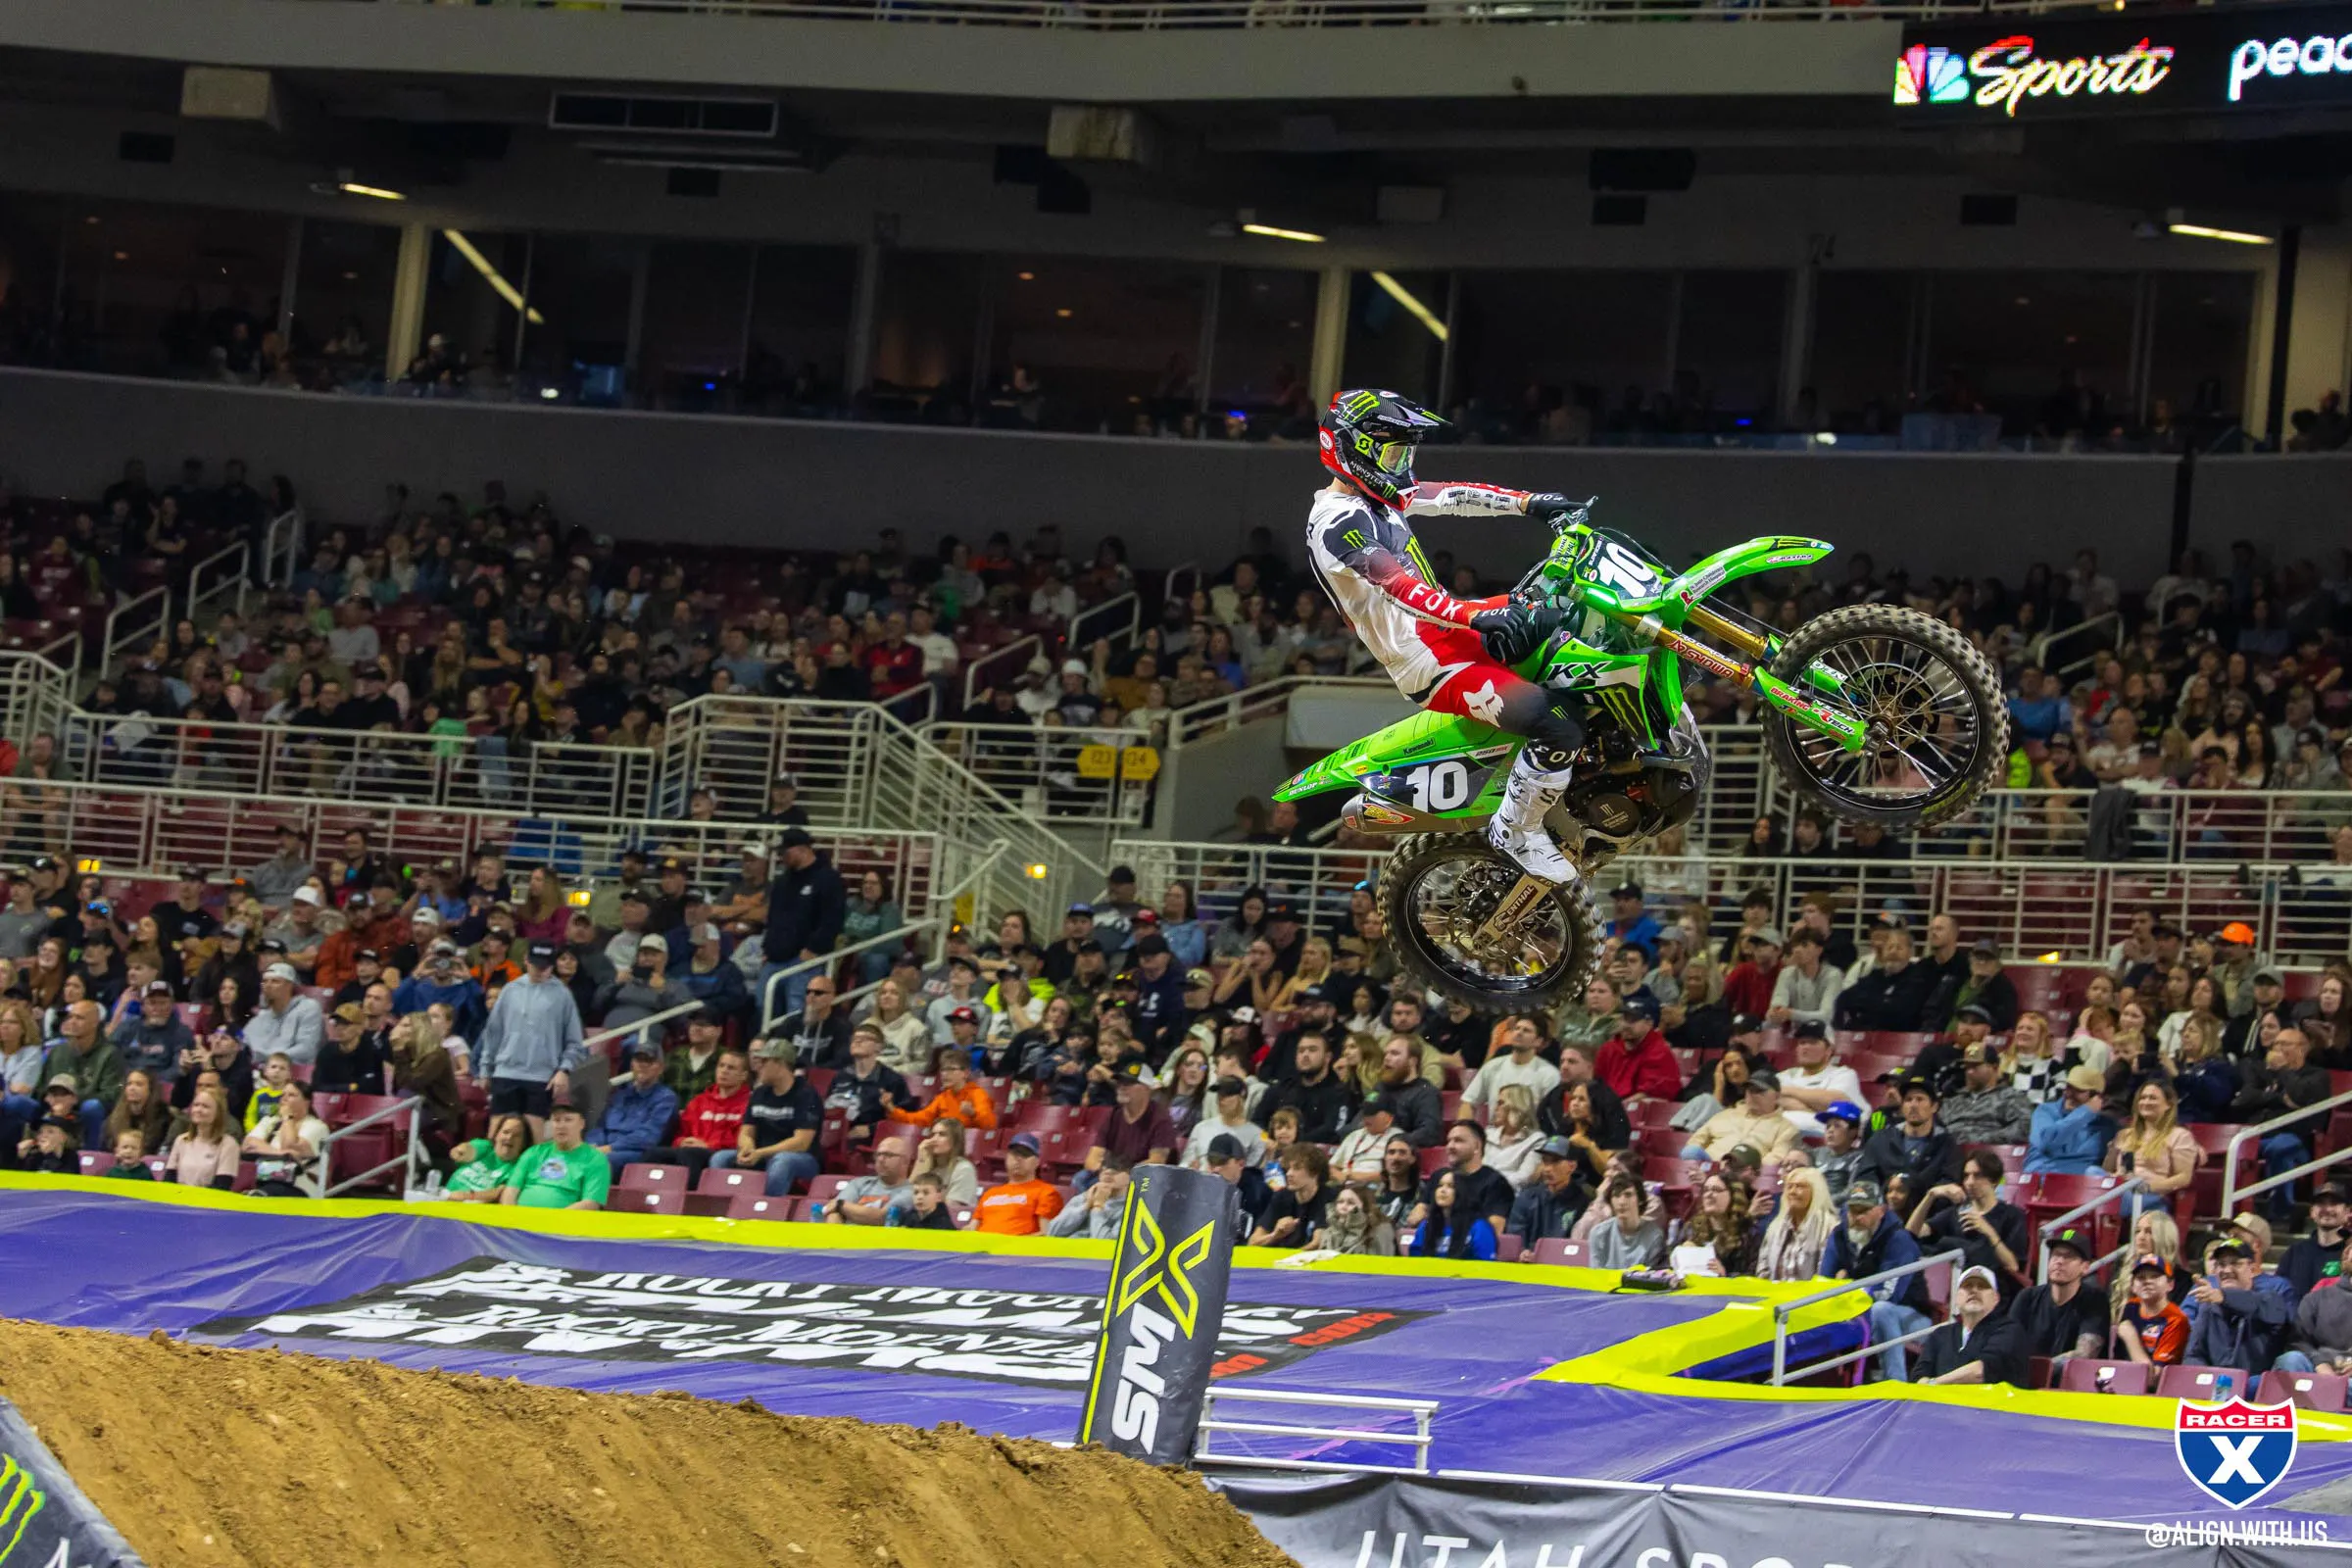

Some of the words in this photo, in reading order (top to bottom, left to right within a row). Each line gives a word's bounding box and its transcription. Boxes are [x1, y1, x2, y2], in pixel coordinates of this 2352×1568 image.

[1968, 35, 2175, 118] Sports
[1597, 542, 1654, 598] 10
[1408, 582, 1463, 620] FOX
[1482, 608, 1511, 617] FOX
[1546, 661, 1614, 681] KX
[1686, 649, 1735, 678] SHOWA
[1770, 686, 1811, 711] BRAKING
[1289, 782, 1318, 797] DUNLOP
[1406, 760, 1469, 813] 10
